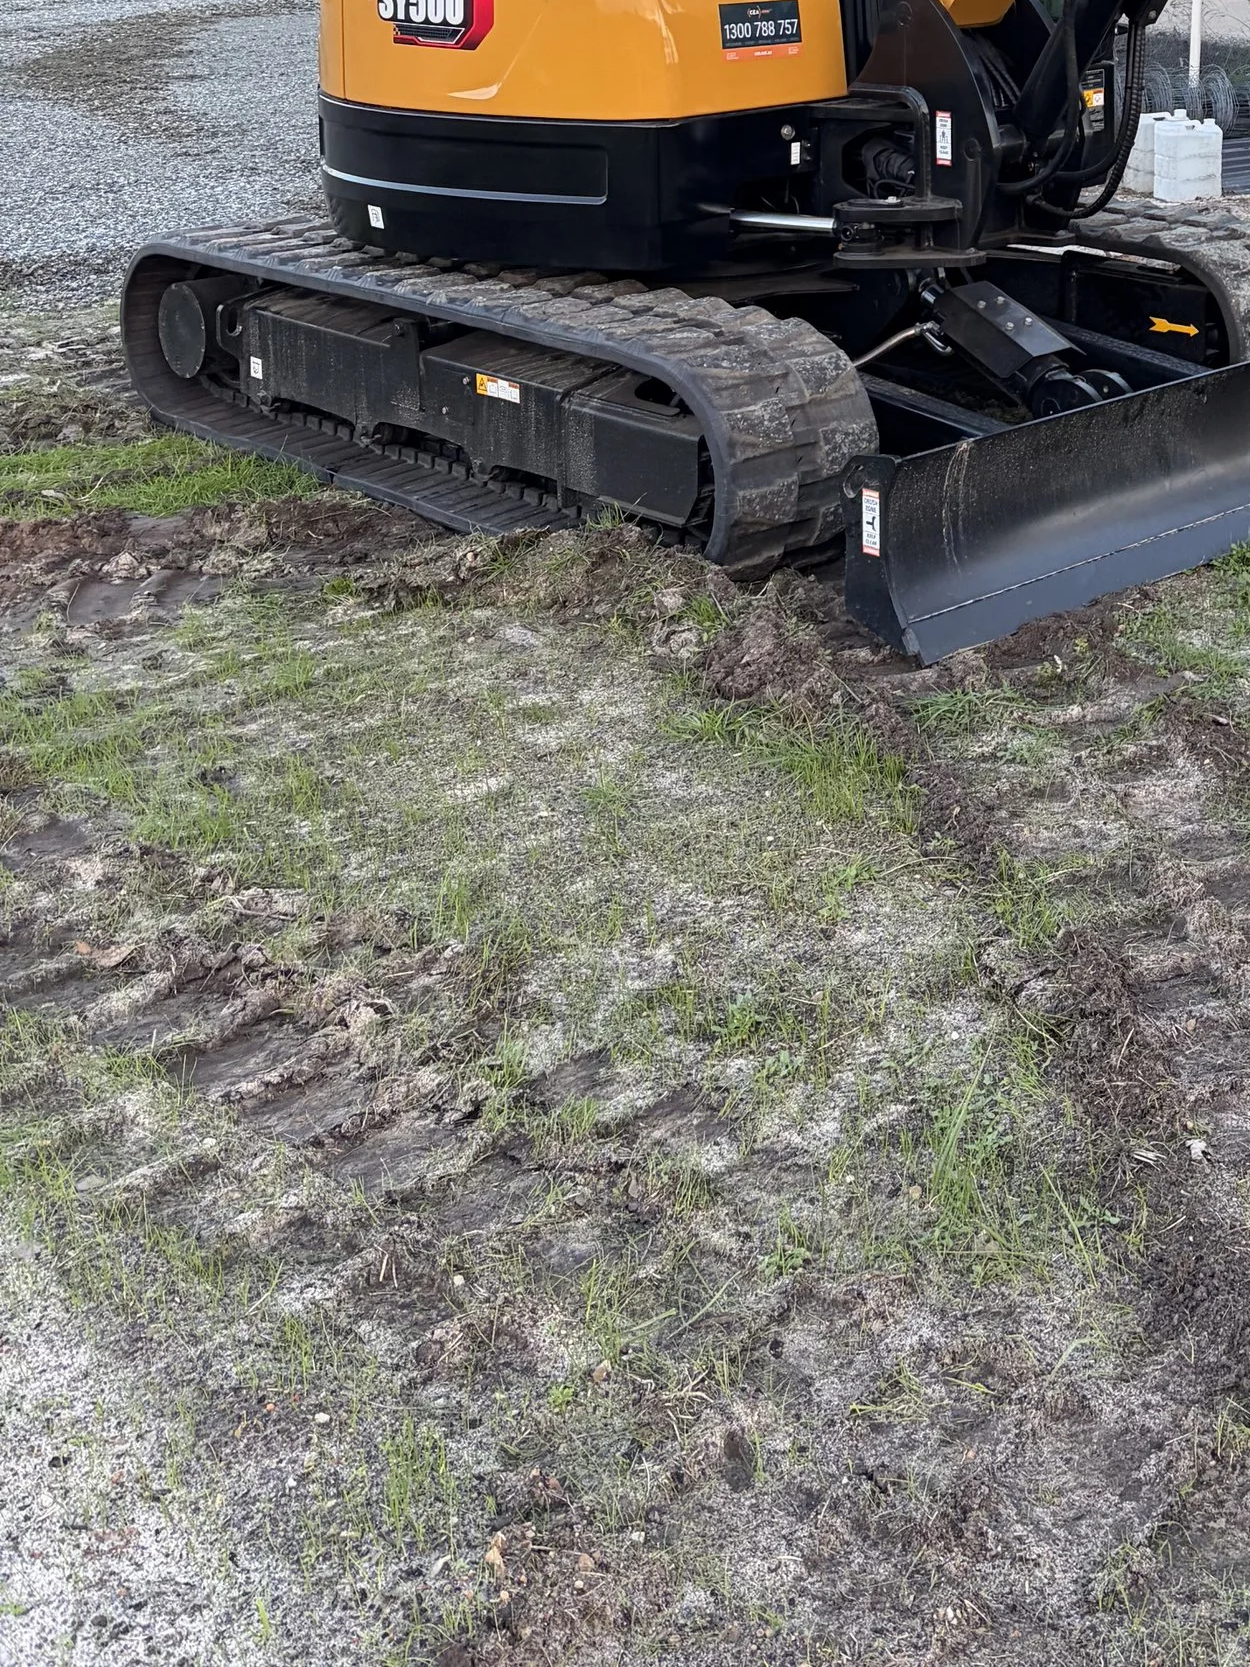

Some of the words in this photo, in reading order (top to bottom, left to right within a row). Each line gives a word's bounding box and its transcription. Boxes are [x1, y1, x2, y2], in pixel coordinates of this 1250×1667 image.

[724, 22, 752, 39] 1300
[754, 21, 775, 37] 788
[777, 19, 798, 35] 757
